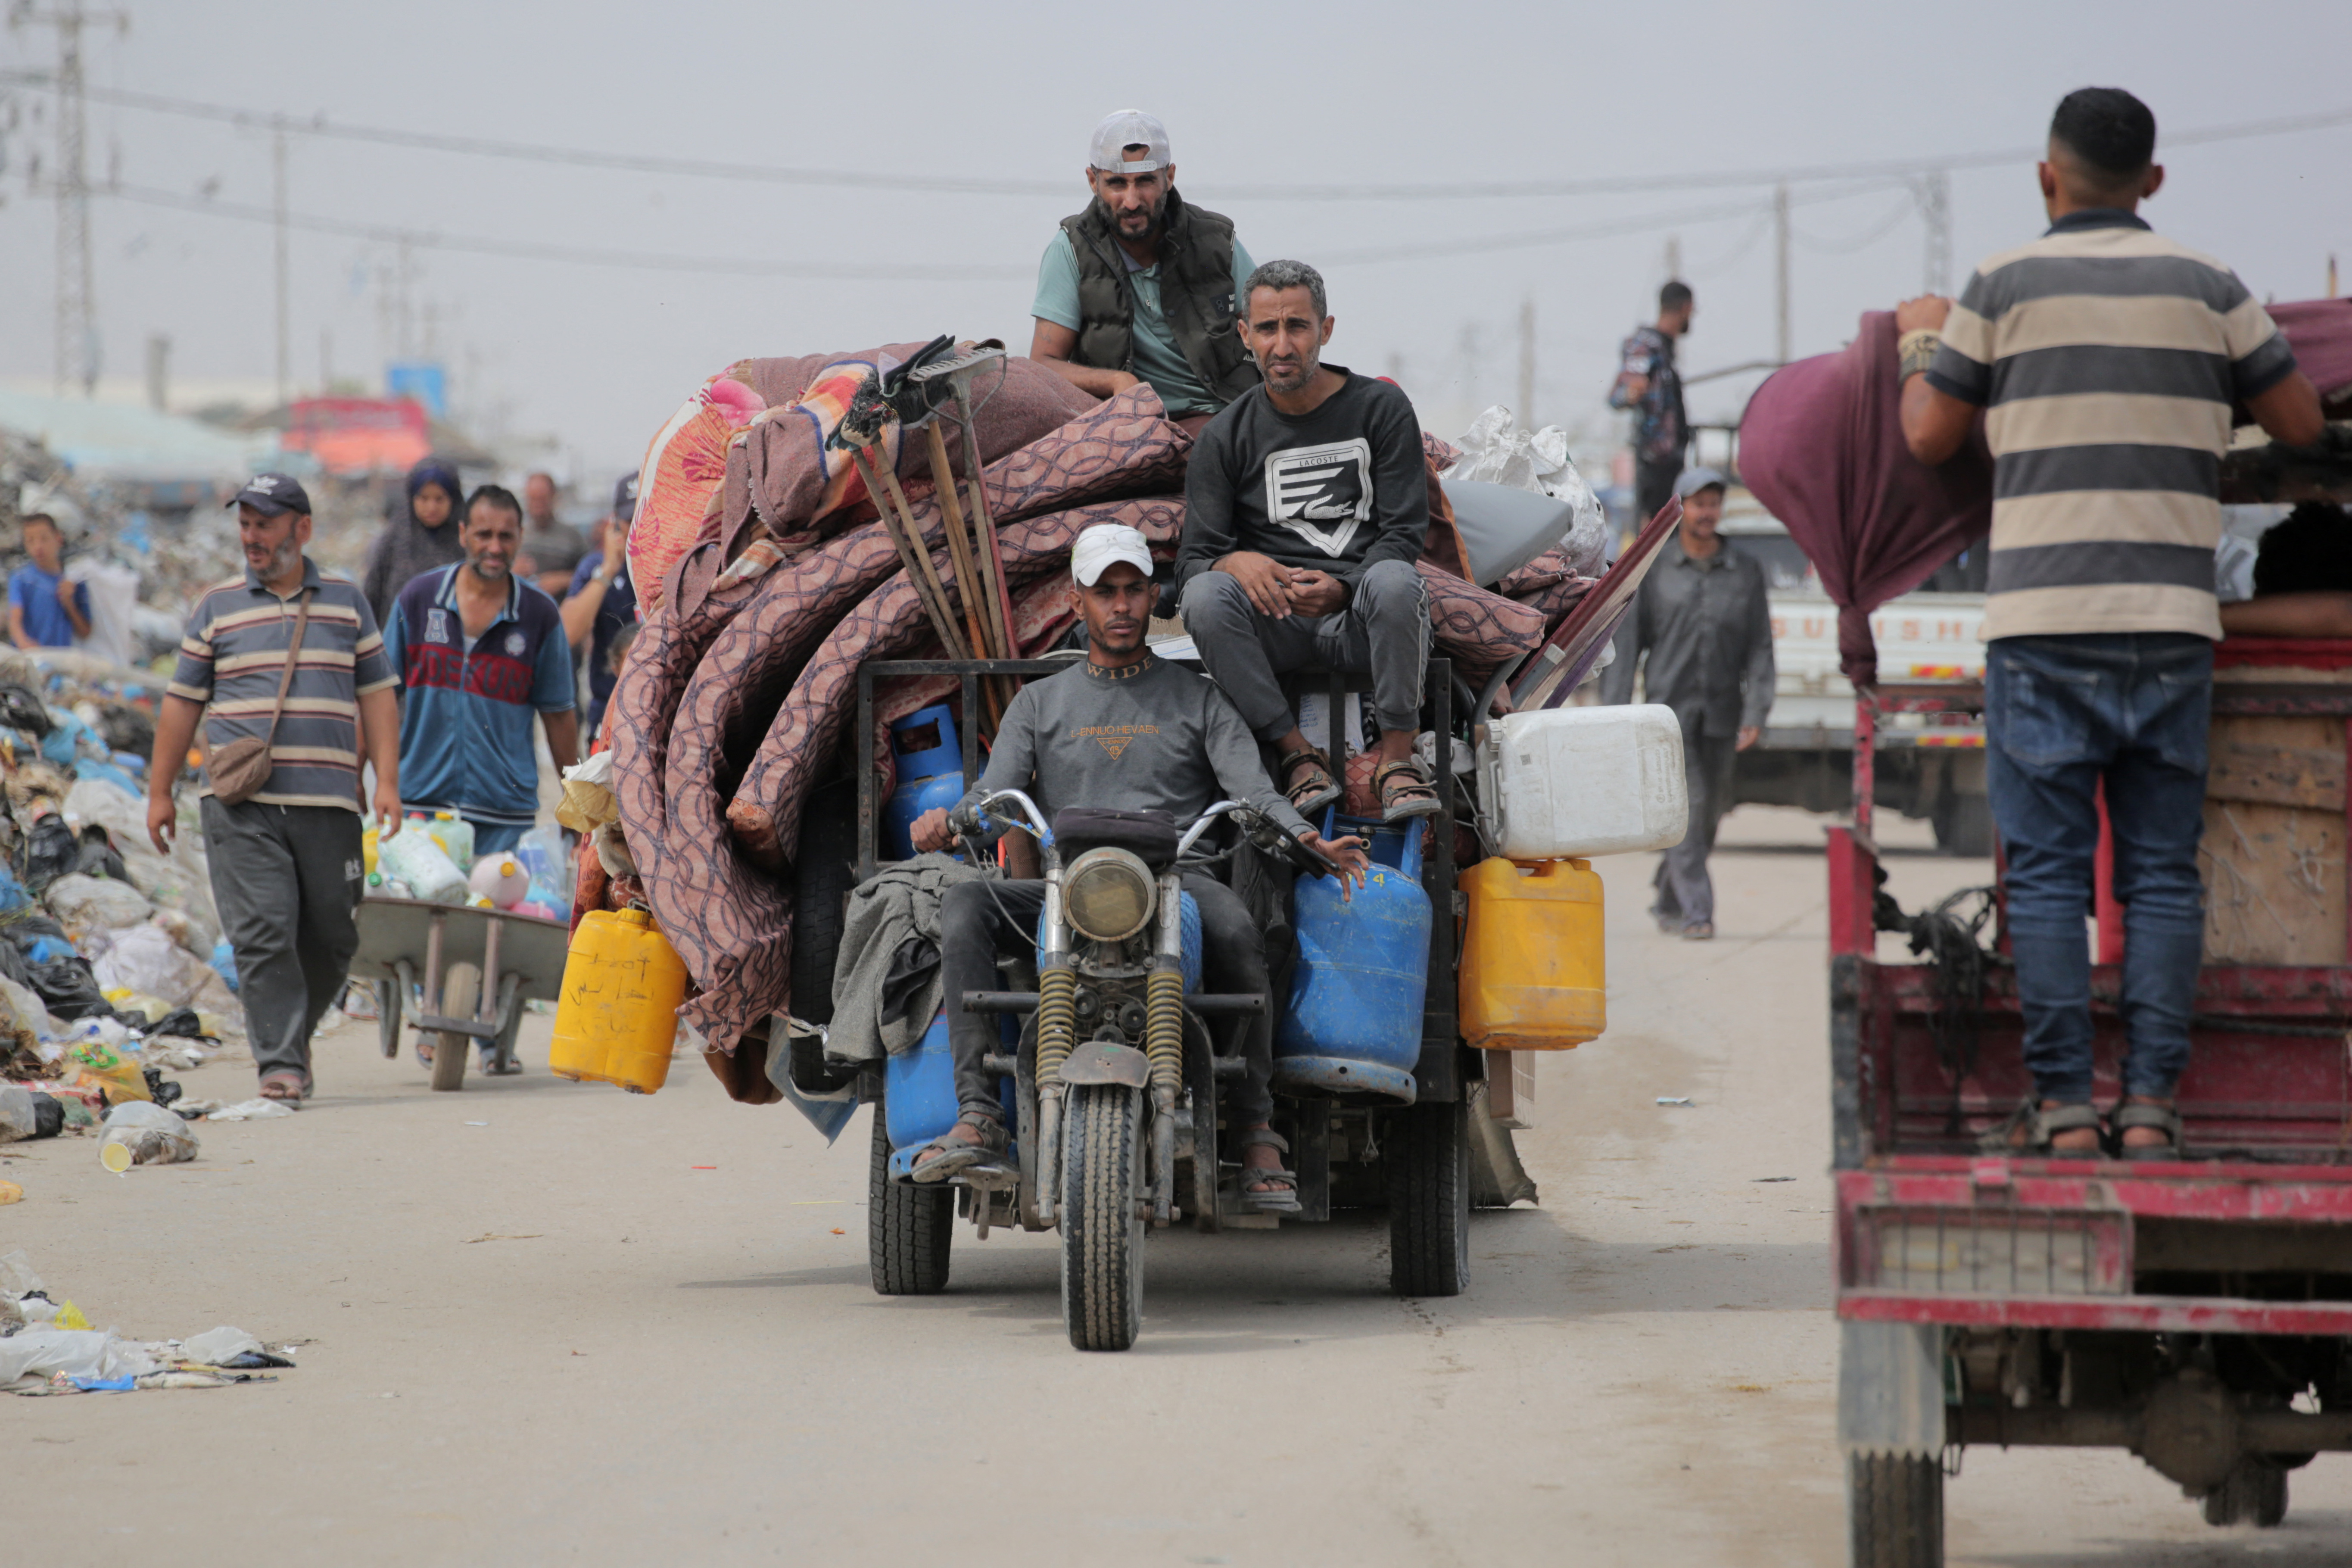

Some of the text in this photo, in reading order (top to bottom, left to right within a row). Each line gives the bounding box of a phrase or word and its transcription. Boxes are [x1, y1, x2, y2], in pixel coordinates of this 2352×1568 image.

[1299, 455, 1338, 467] LACOSTE
[424, 608, 449, 644] A
[1086, 656, 1153, 680] WIDE
